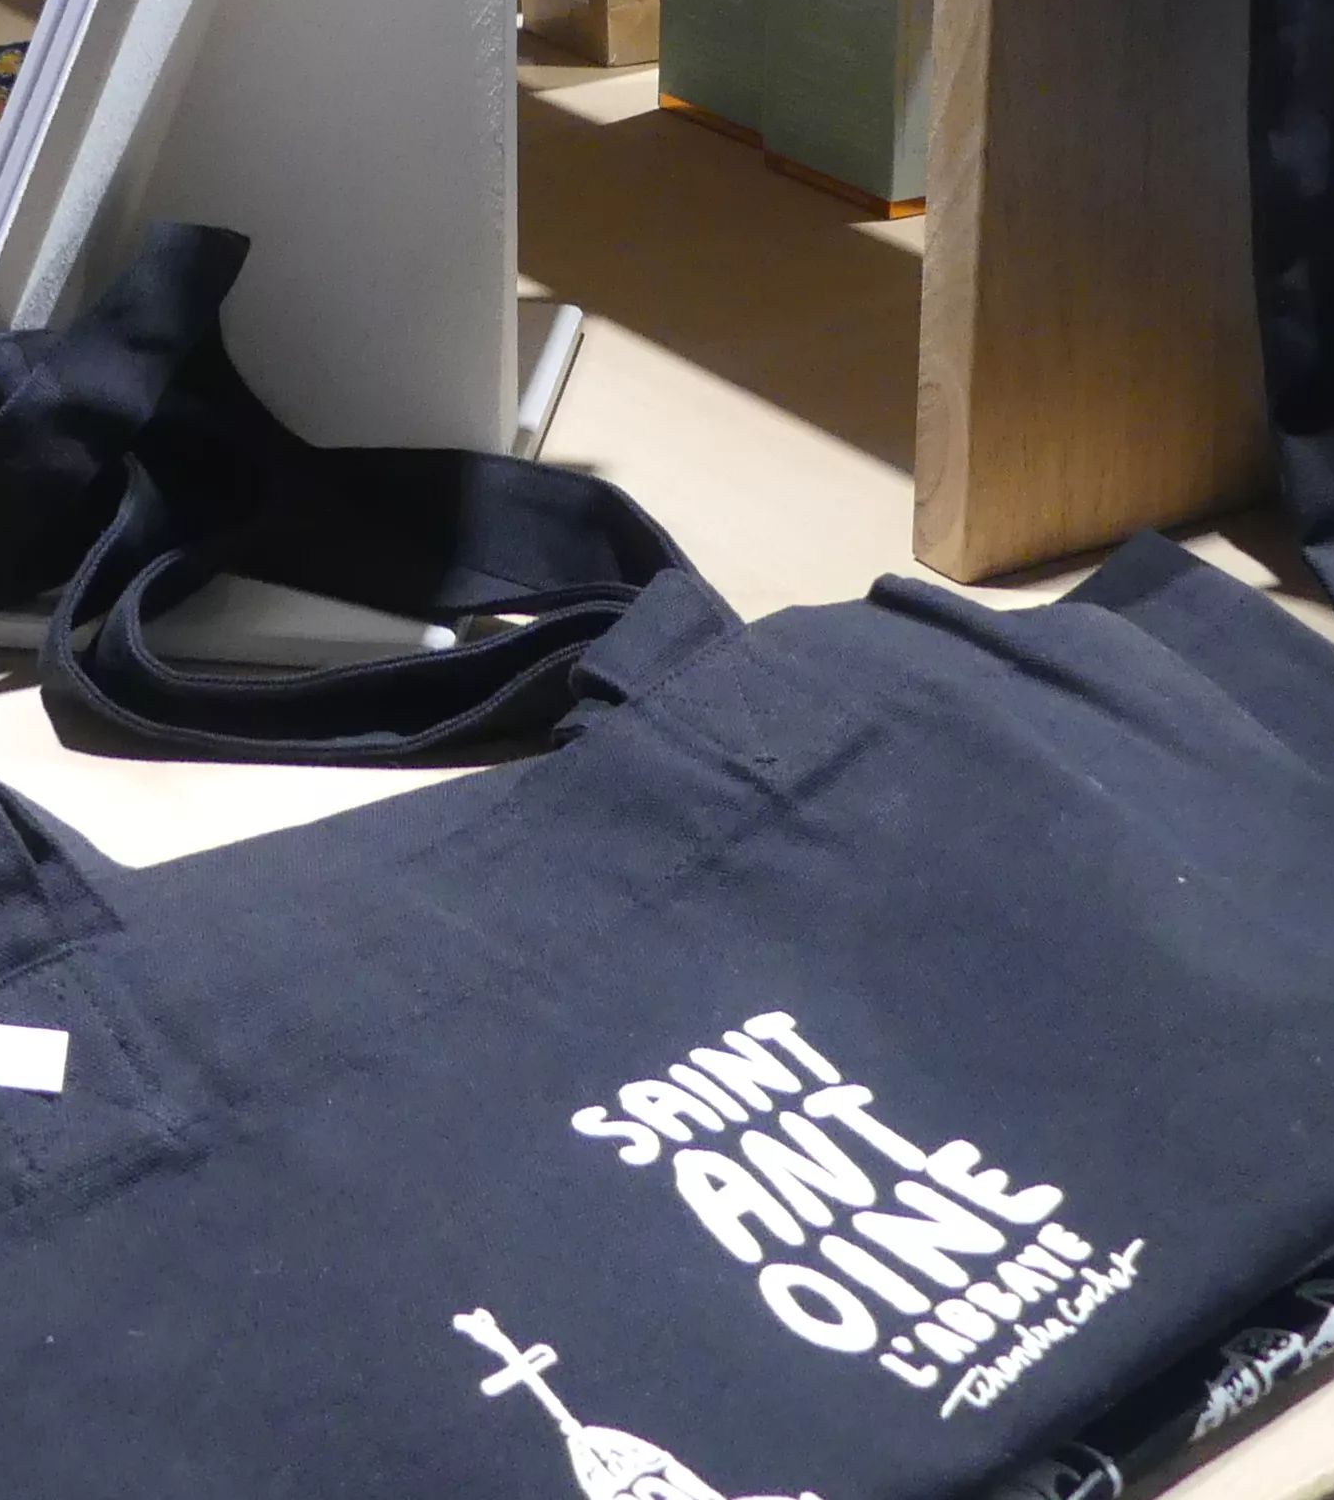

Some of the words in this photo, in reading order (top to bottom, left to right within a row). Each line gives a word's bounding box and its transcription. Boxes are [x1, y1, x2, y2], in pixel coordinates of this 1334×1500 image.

[571, 1011, 842, 1166] SAINT
[673, 1084, 928, 1264] ANT
[758, 1139, 1064, 1354] OINE
[880, 1223, 1093, 1388] L'ABBAYE
